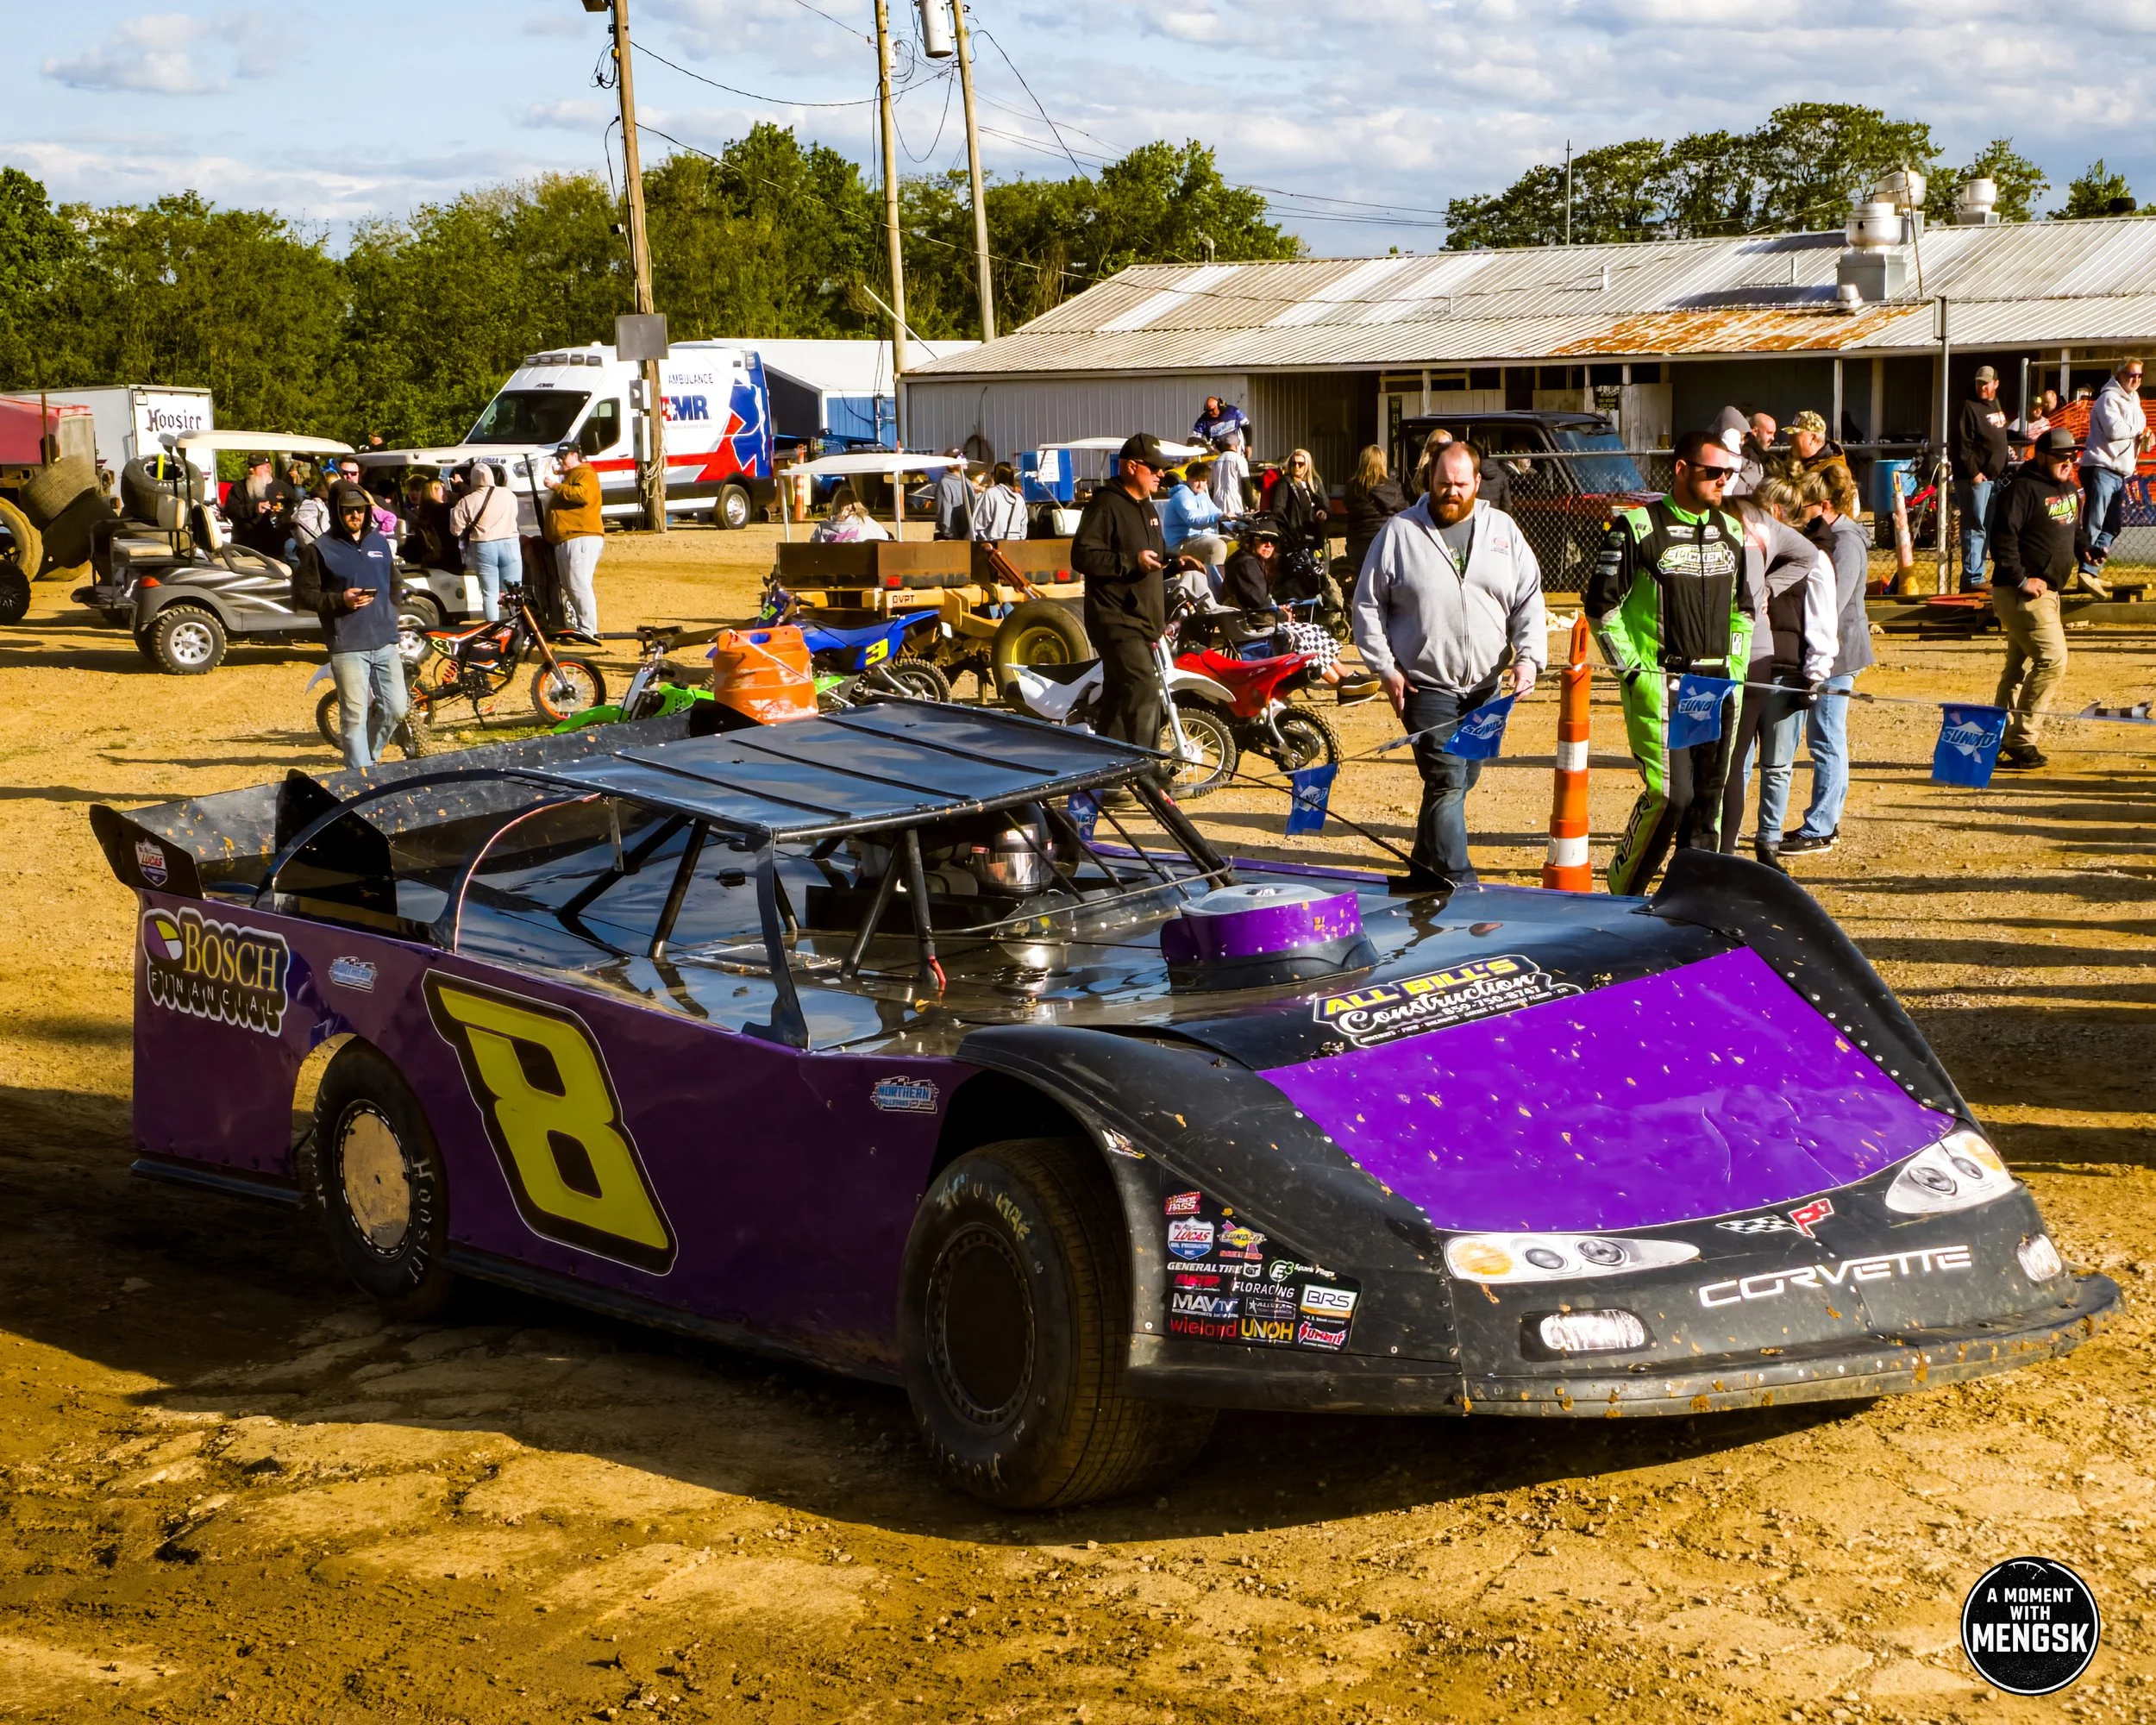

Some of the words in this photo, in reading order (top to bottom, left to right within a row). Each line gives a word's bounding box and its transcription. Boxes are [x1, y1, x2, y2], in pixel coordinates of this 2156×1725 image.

[668, 373, 713, 385] AMBULANCE
[661, 395, 709, 421] AMR
[145, 408, 202, 432] Hoosier
[183, 922, 279, 992] BOSCH
[151, 972, 273, 1015] FINANCIAL
[1325, 988, 1401, 1016] ALL
[1401, 959, 1520, 995] BILL'S
[1338, 973, 1537, 1033] Construction
[878, 1086, 931, 1101] NORTHERN
[436, 984, 670, 1251] 8
[1173, 1230, 1212, 1241] LUCAS
[1223, 1233, 1264, 1242] SUNOCO
[1167, 1262, 1218, 1273] GENERAL
[1294, 1263, 1315, 1274] Spark
[1698, 1245, 1972, 1308] CORVETTE
[1307, 1290, 1351, 1308] BRS
[1242, 1319, 1294, 1341] UNOH
